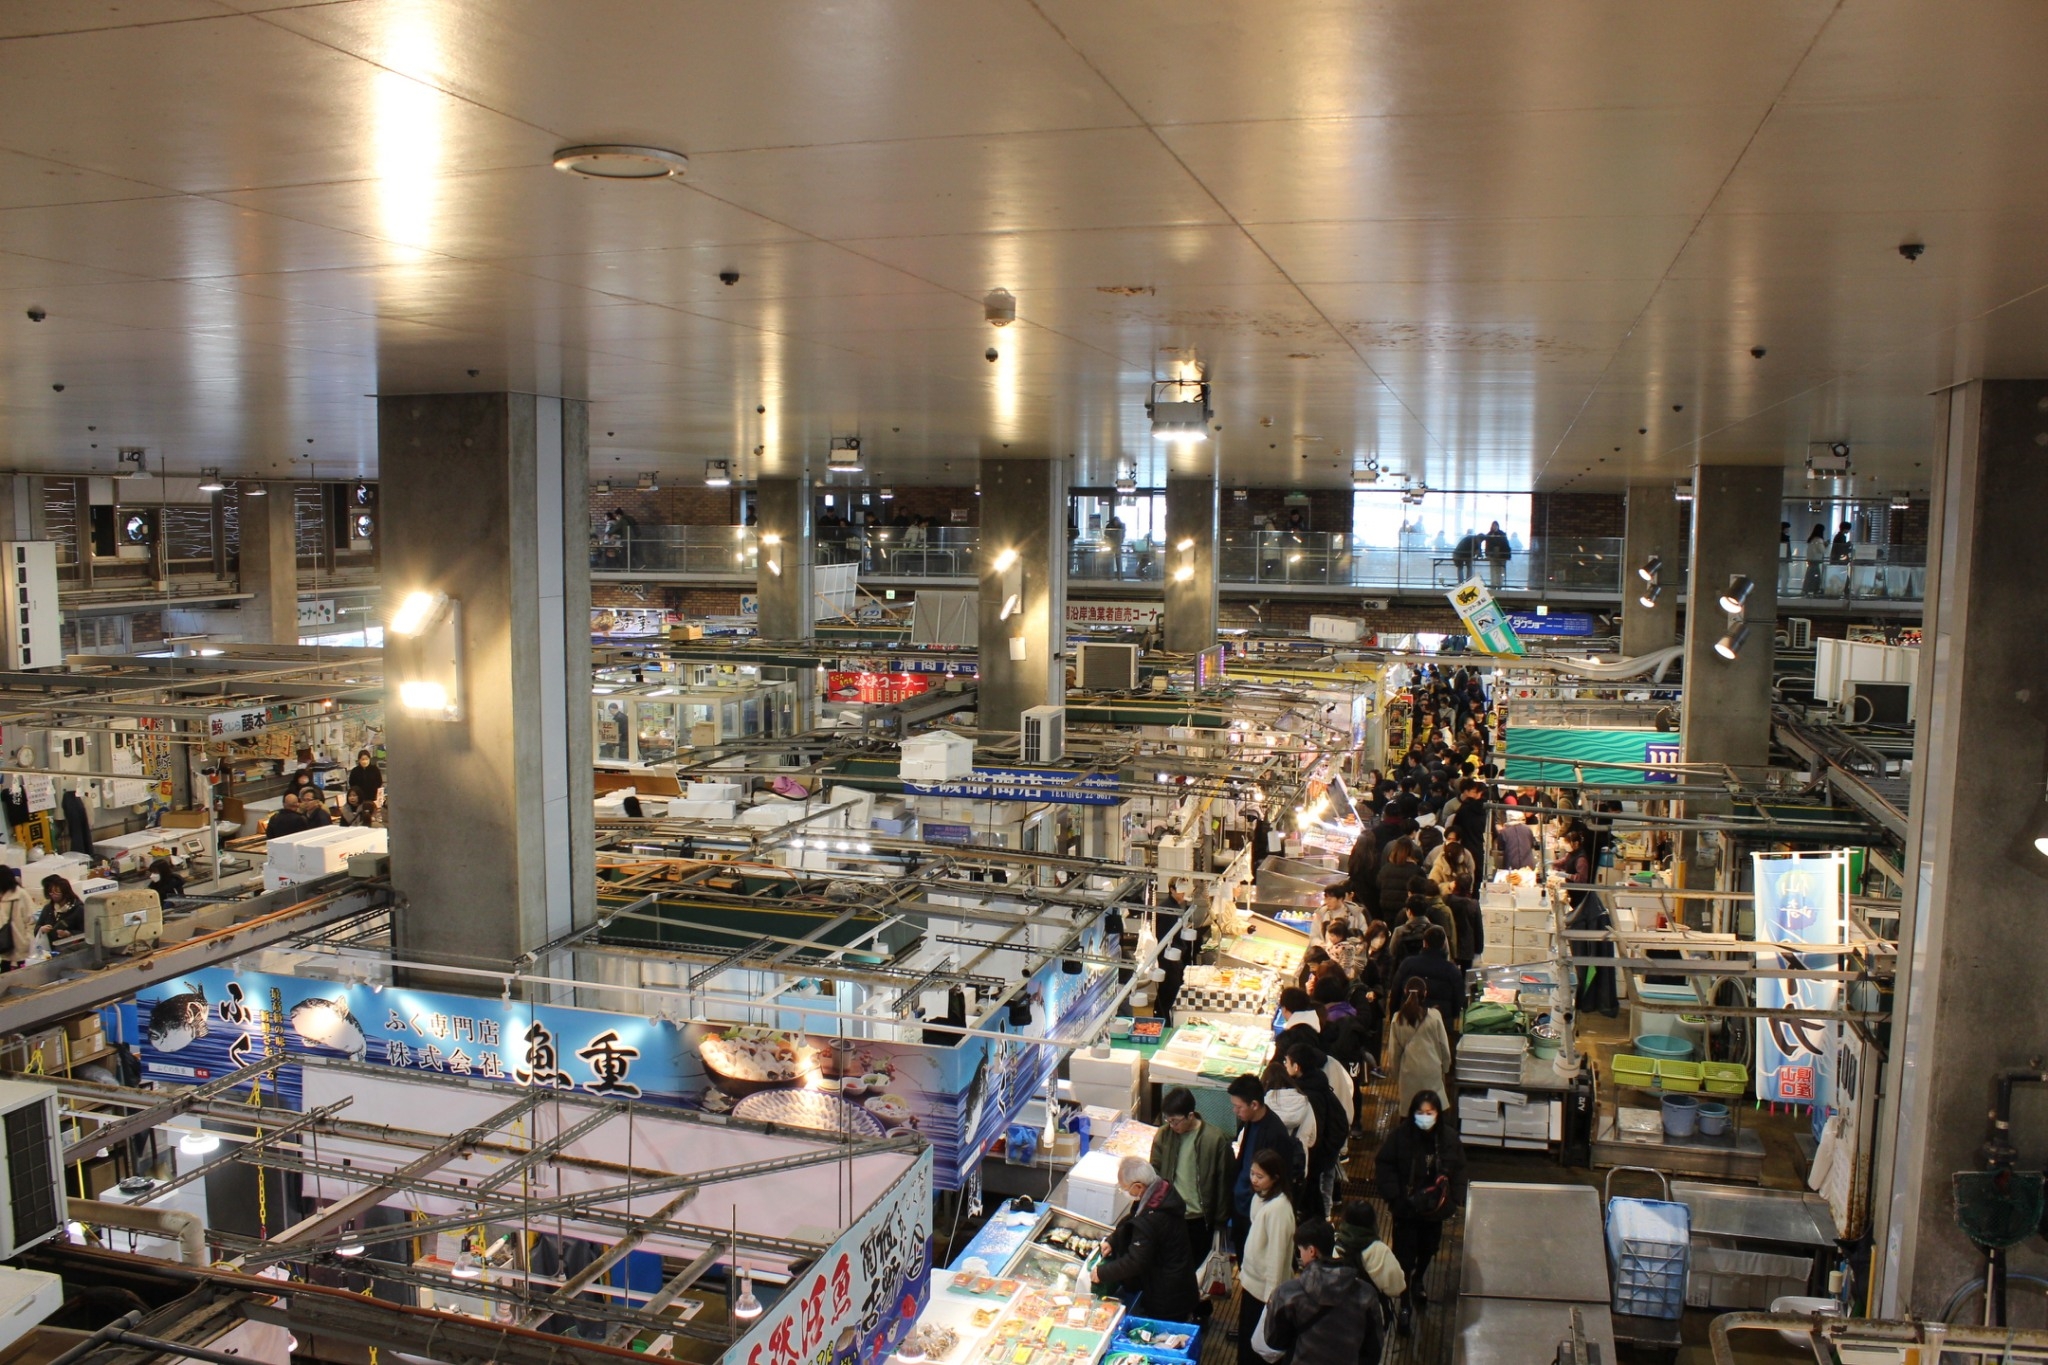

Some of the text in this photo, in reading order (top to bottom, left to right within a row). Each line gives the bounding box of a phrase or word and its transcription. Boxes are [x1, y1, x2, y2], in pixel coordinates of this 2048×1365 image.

[854, 674, 925, 690] 冷凍コーナー
[211, 712, 266, 737] 鯨くじら藤本
[386, 1010, 500, 1046] ふく専門店
[386, 1041, 504, 1079] 株式会社
[513, 1020, 642, 1098] 魚重
